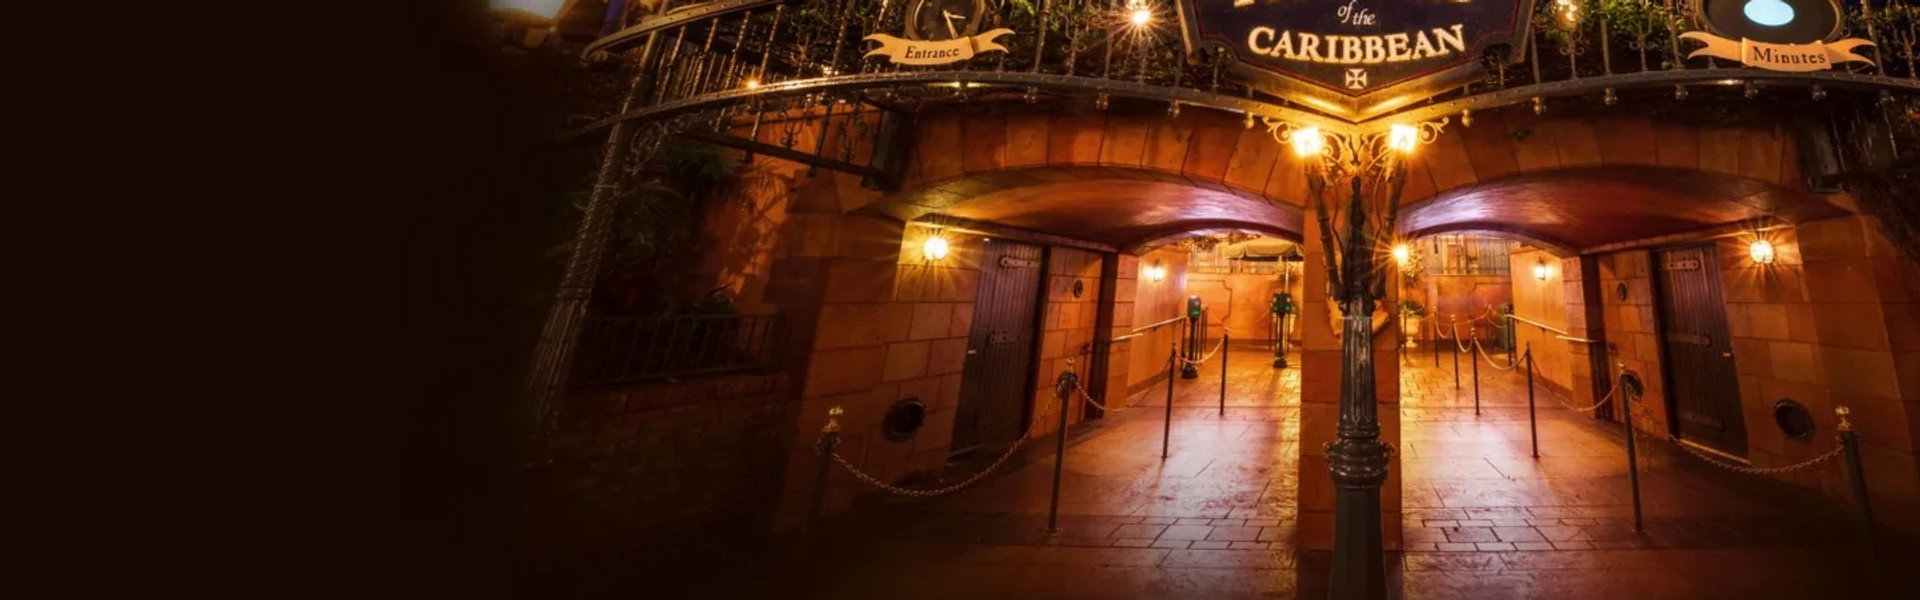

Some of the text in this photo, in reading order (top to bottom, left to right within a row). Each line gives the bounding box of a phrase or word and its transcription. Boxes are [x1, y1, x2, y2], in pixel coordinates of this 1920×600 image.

[1337, 0, 1376, 26] of the
[904, 45, 960, 59] Entrance
[1248, 24, 1466, 63] CARIBBEAN
[1752, 46, 1826, 64] Minutes
